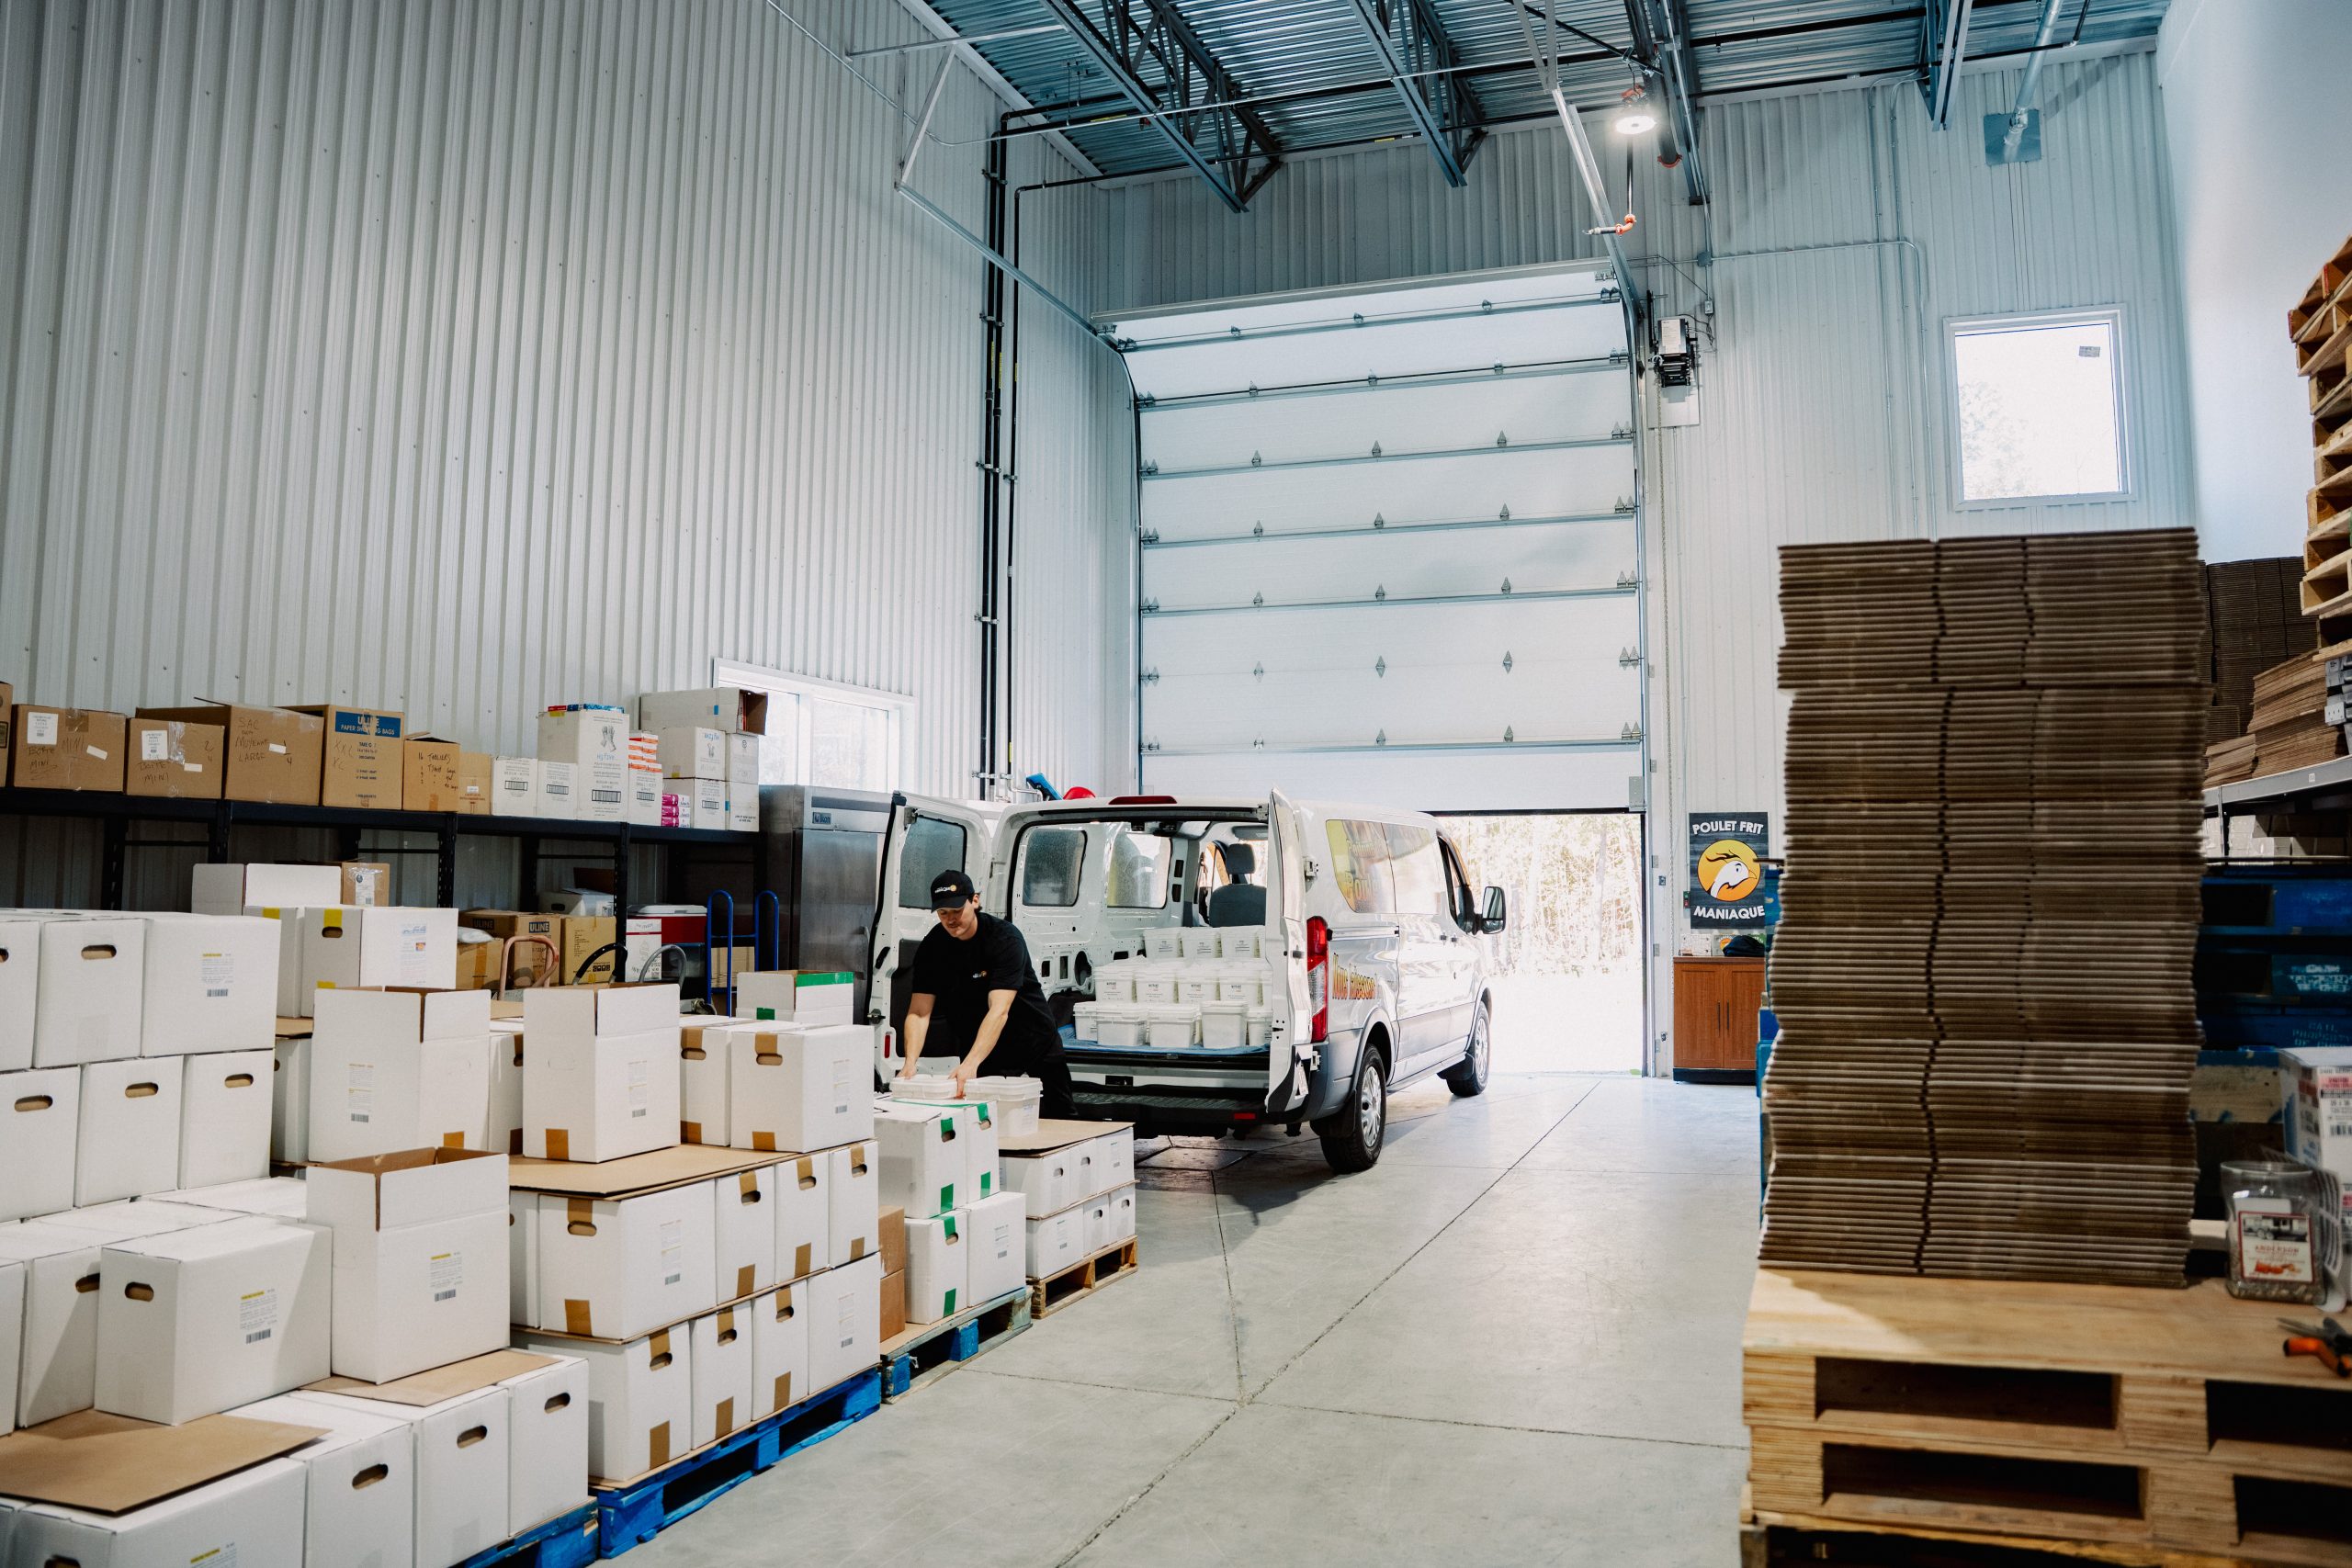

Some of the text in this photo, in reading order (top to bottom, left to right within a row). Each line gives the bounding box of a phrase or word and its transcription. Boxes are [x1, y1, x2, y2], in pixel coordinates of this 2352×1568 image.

[357, 716, 379, 727] ULIE
[1691, 820, 1764, 835] POULET FRIT
[1693, 905, 1766, 919] MANIAQUE
[529, 922, 550, 932] ULINE
